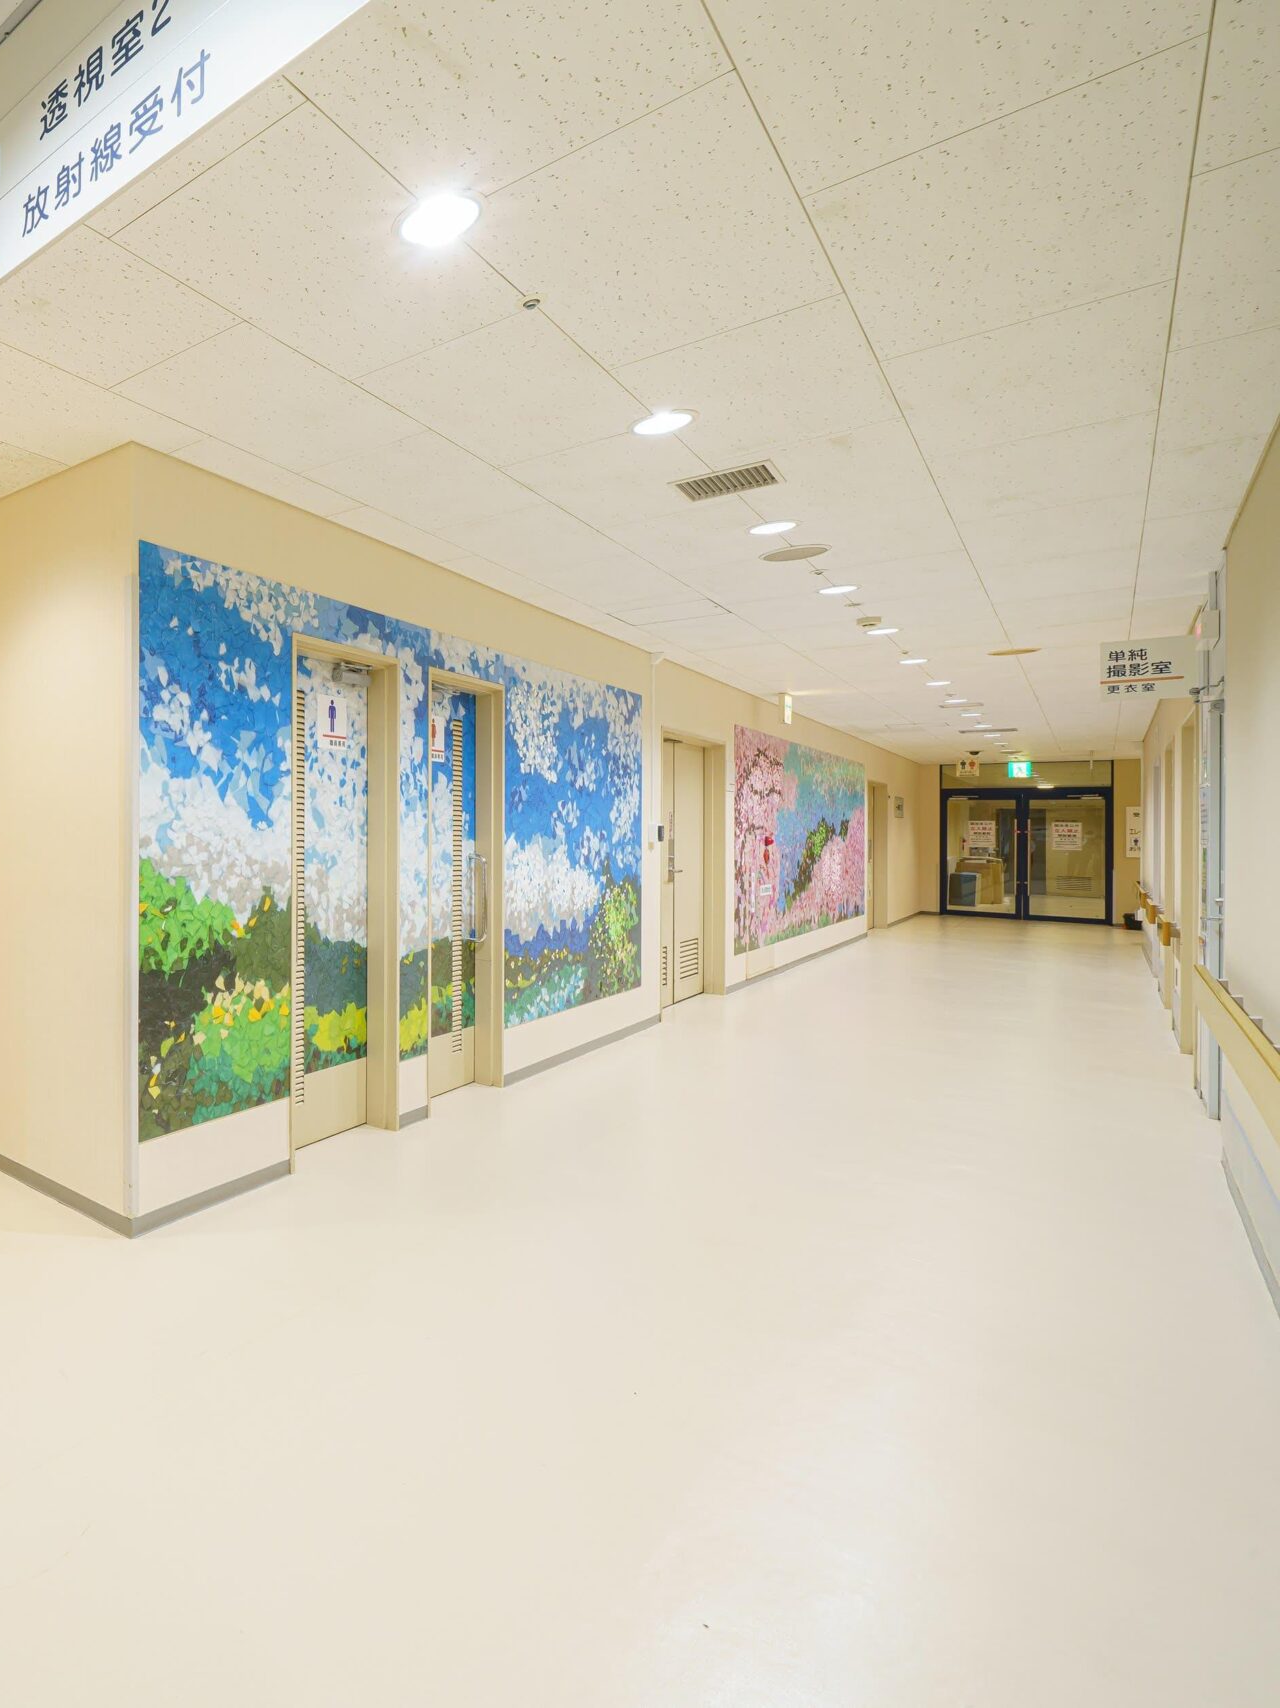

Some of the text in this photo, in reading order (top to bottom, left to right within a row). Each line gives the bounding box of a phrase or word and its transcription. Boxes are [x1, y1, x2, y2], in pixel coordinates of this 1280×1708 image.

[39, 0, 172, 141] 透視室2
[22, 48, 211, 238] 放射線受付
[1108, 648, 1148, 662] 単純
[1107, 661, 1172, 678] 撮影室
[1107, 683, 1156, 694] 更衣室
